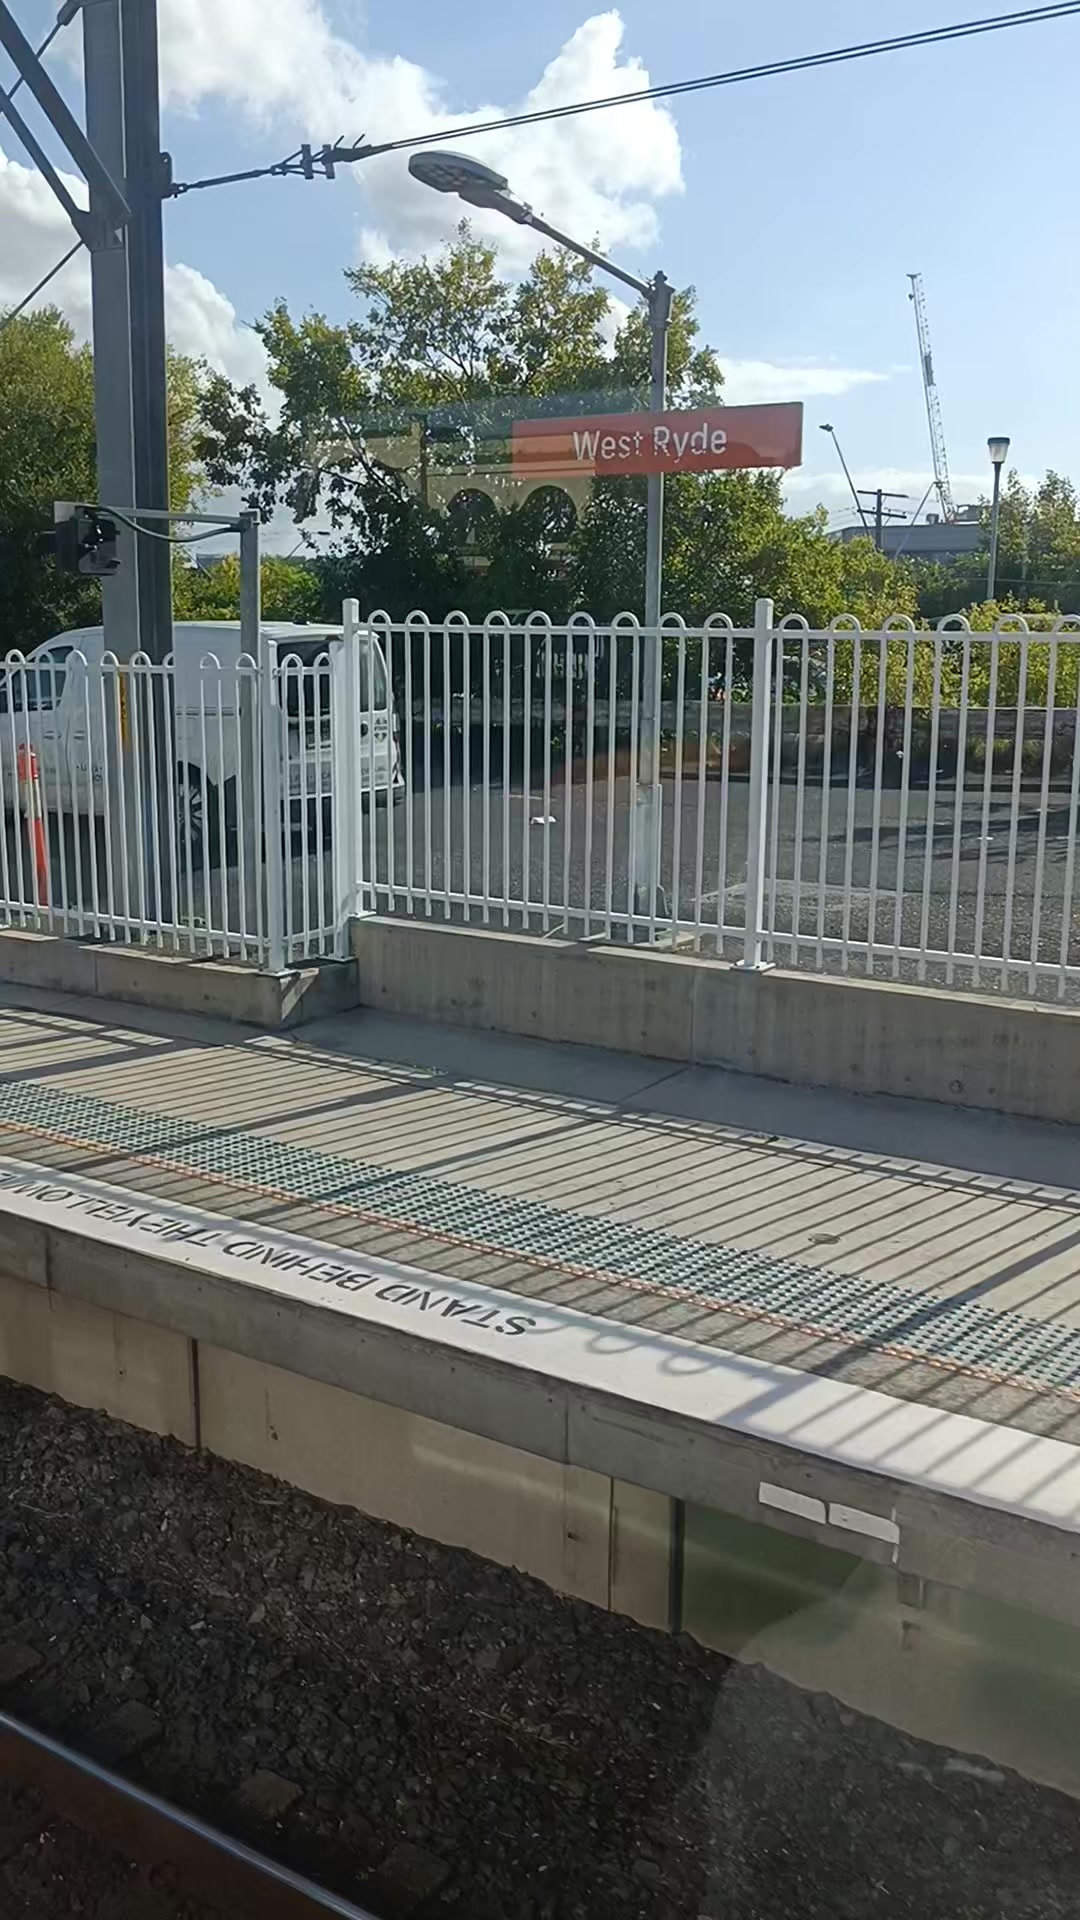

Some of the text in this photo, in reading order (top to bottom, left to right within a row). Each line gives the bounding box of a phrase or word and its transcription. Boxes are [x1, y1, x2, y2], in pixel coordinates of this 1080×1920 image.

[573, 421, 728, 464] West Ryde
[0, 1180, 537, 1336] STAND BEHIND THE YELLOW
